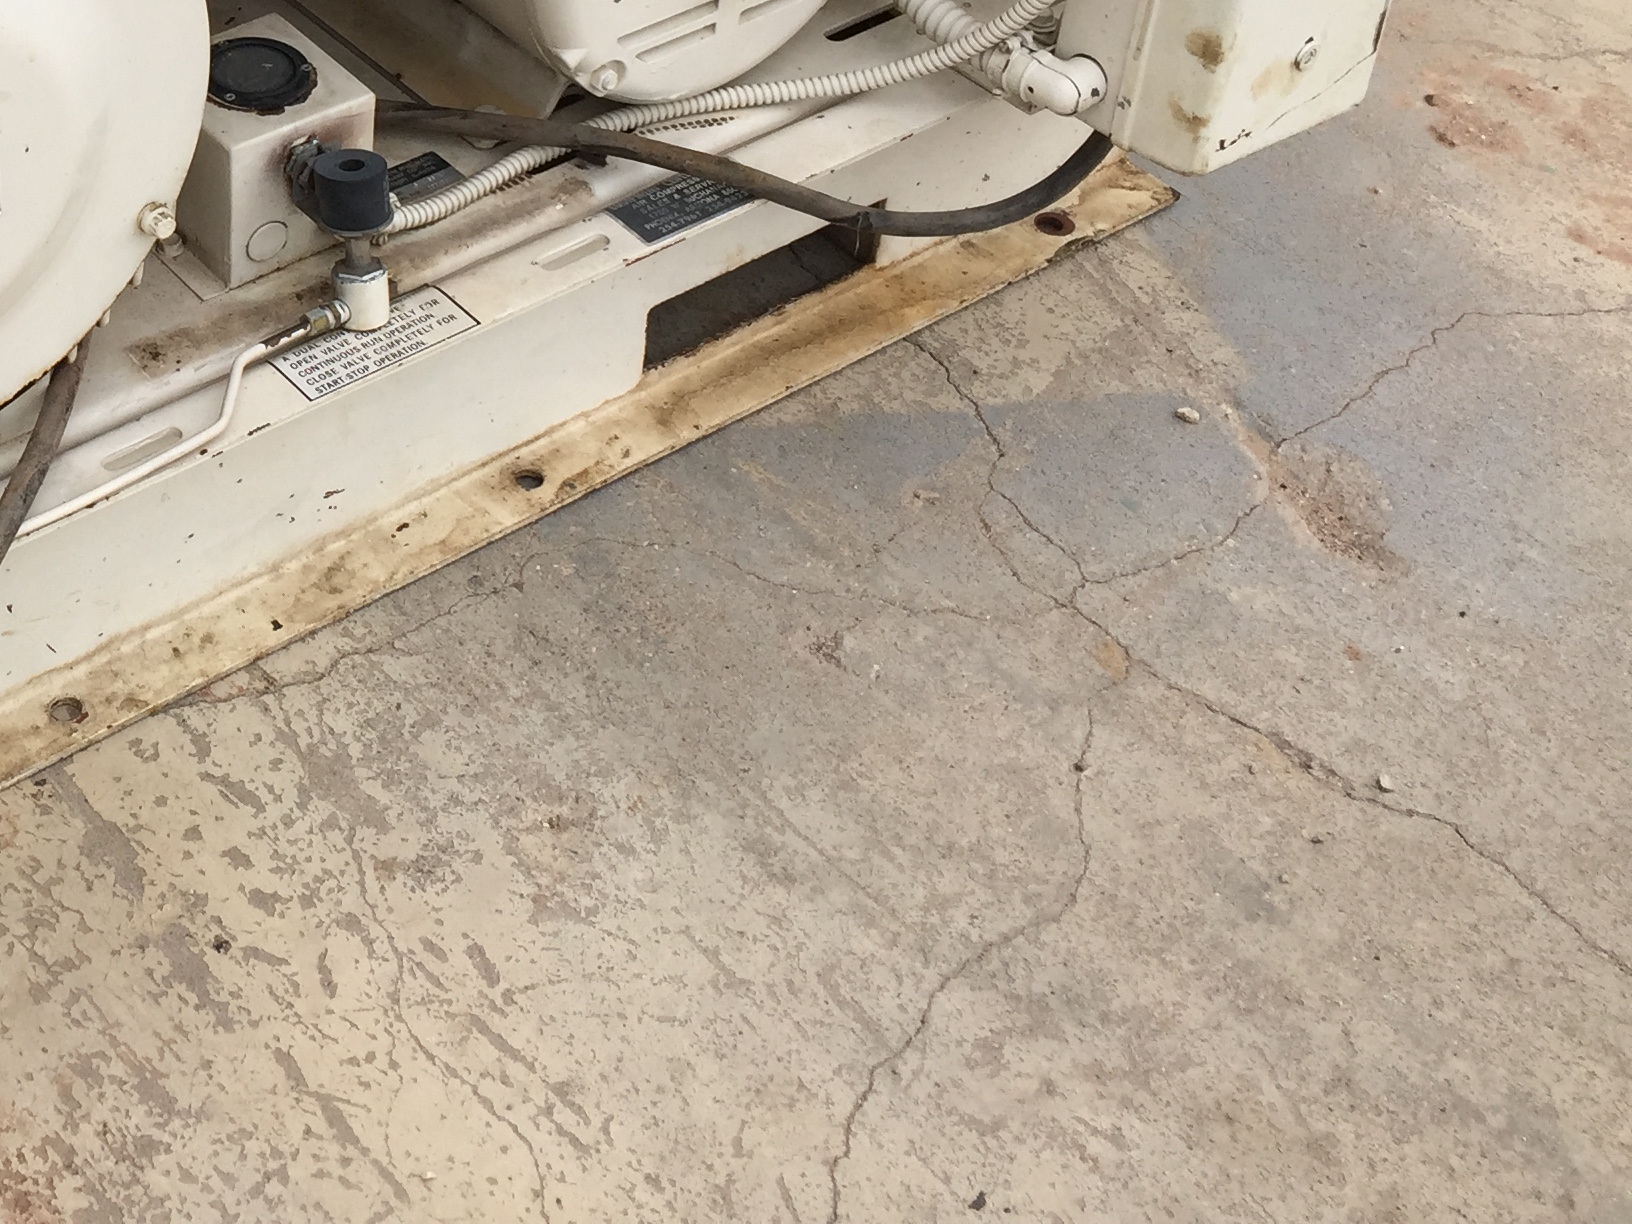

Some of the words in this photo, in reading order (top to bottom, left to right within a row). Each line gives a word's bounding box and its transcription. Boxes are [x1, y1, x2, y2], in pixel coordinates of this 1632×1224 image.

[632, 198, 647, 210] AIR
[289, 354, 318, 370] OPEN
[320, 338, 351, 356] VALVE
[419, 298, 440, 312] FOR
[292, 342, 321, 358] DUAL
[306, 368, 339, 386] CLOSE
[340, 353, 372, 370] VALVE
[373, 323, 435, 355] COMPLETELY
[436, 313, 458, 326] FOR
